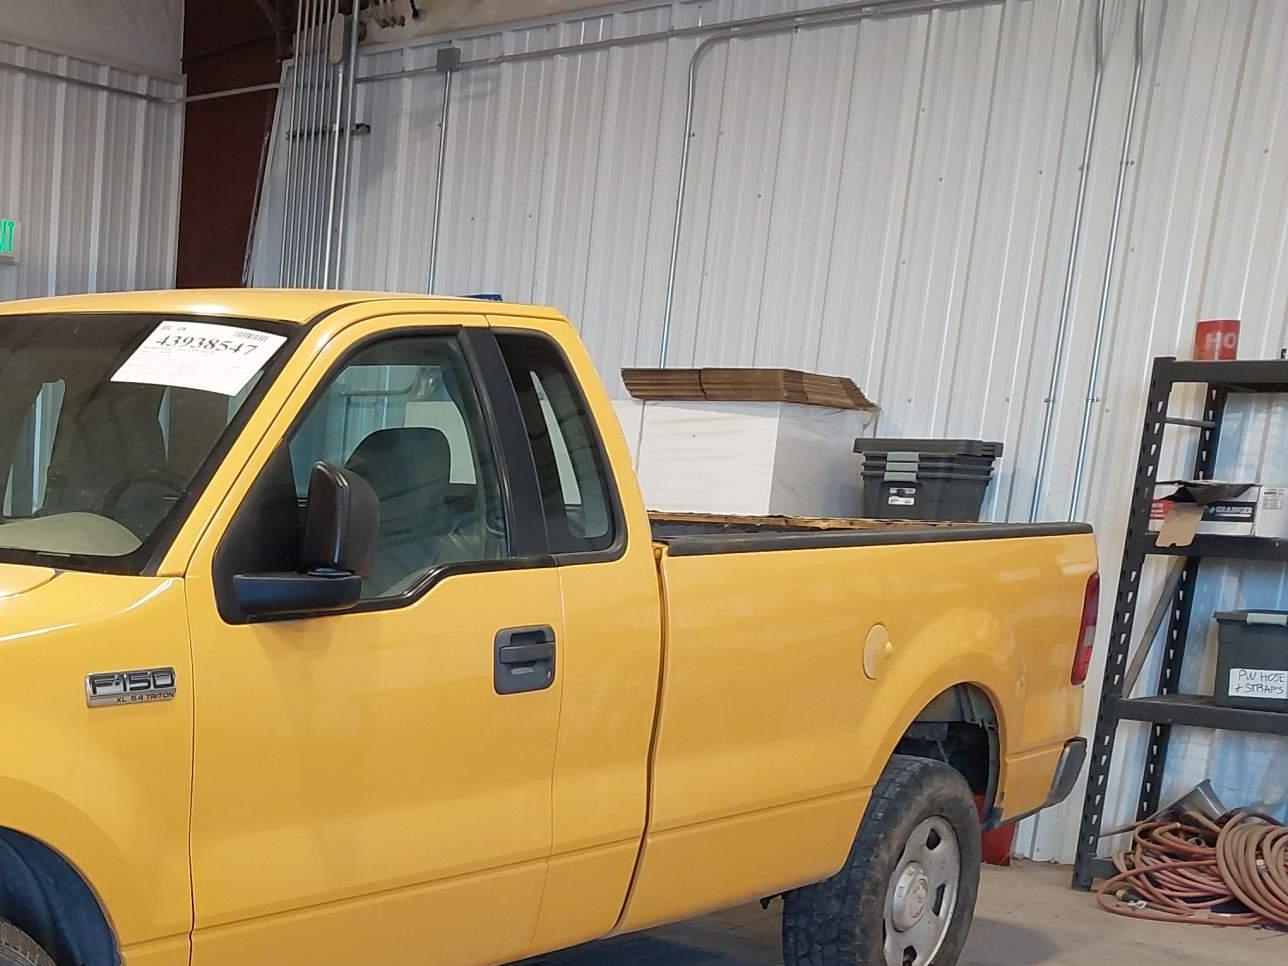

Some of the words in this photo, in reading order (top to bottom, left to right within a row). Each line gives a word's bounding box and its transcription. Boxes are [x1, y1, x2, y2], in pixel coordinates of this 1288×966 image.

[155, 334, 259, 356] 43938547
[1238, 669, 1257, 681] PW
[1260, 671, 1286, 683] HOSE
